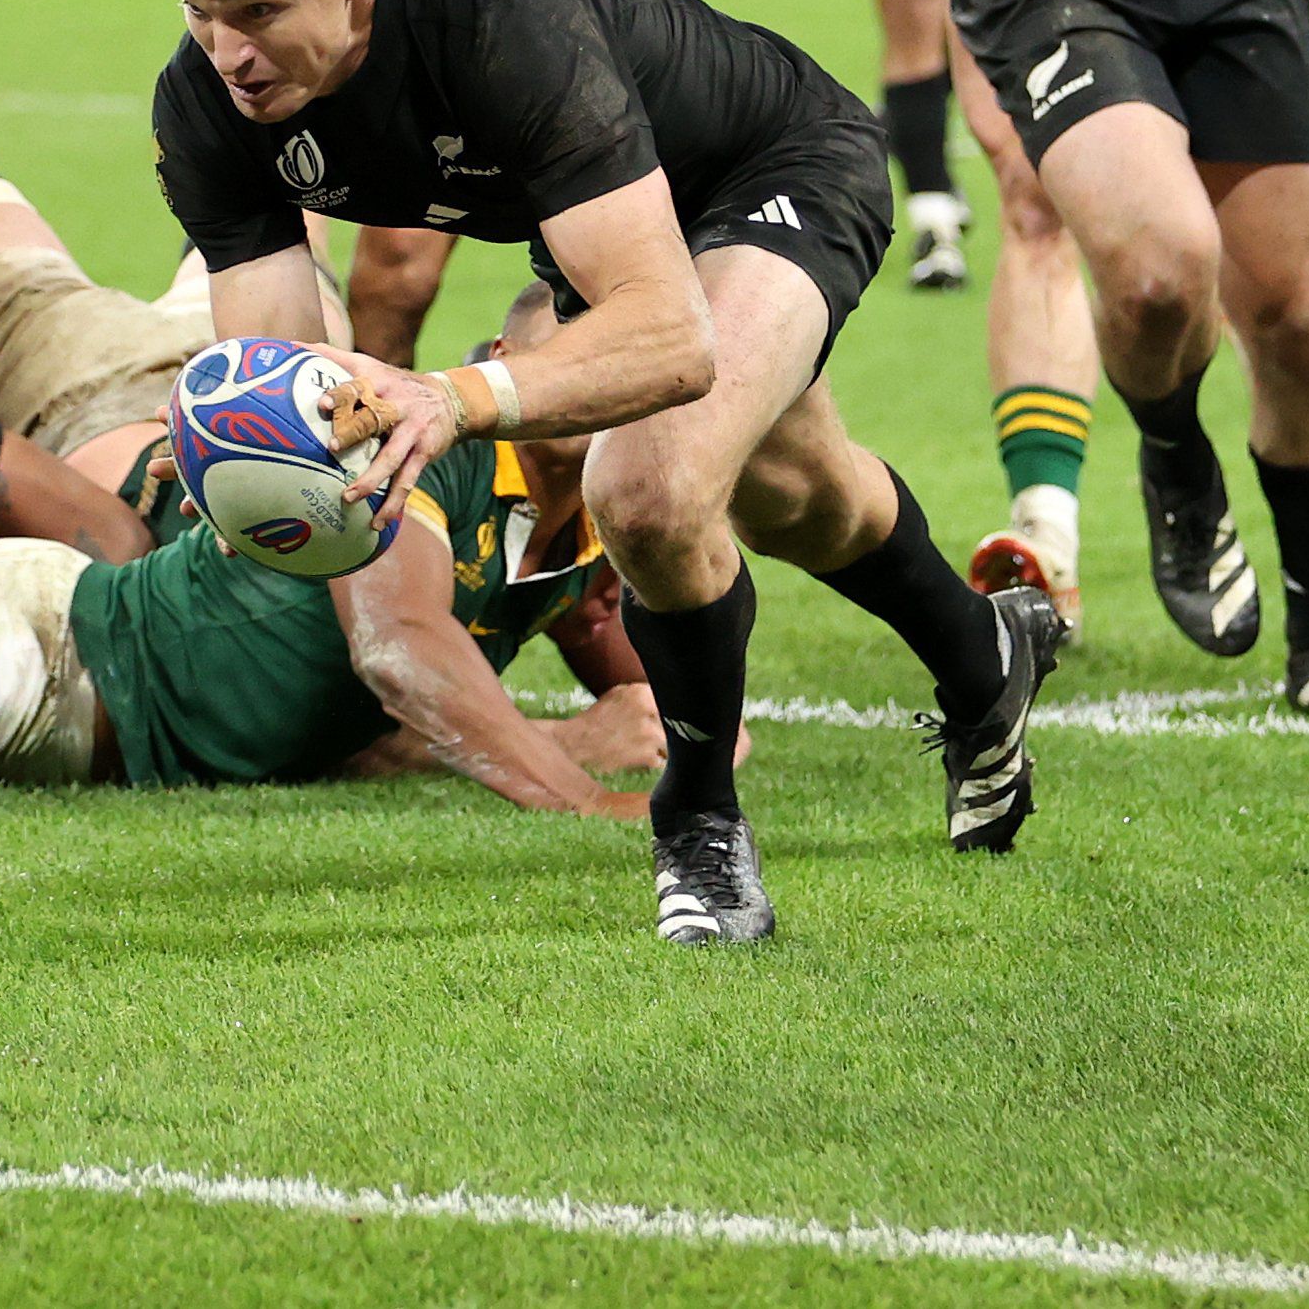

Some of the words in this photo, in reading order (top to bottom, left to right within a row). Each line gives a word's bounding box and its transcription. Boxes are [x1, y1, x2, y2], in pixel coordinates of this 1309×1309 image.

[329, 186, 350, 200] CUP
[300, 488, 319, 507] CUP
[316, 505, 346, 534] WORLD
